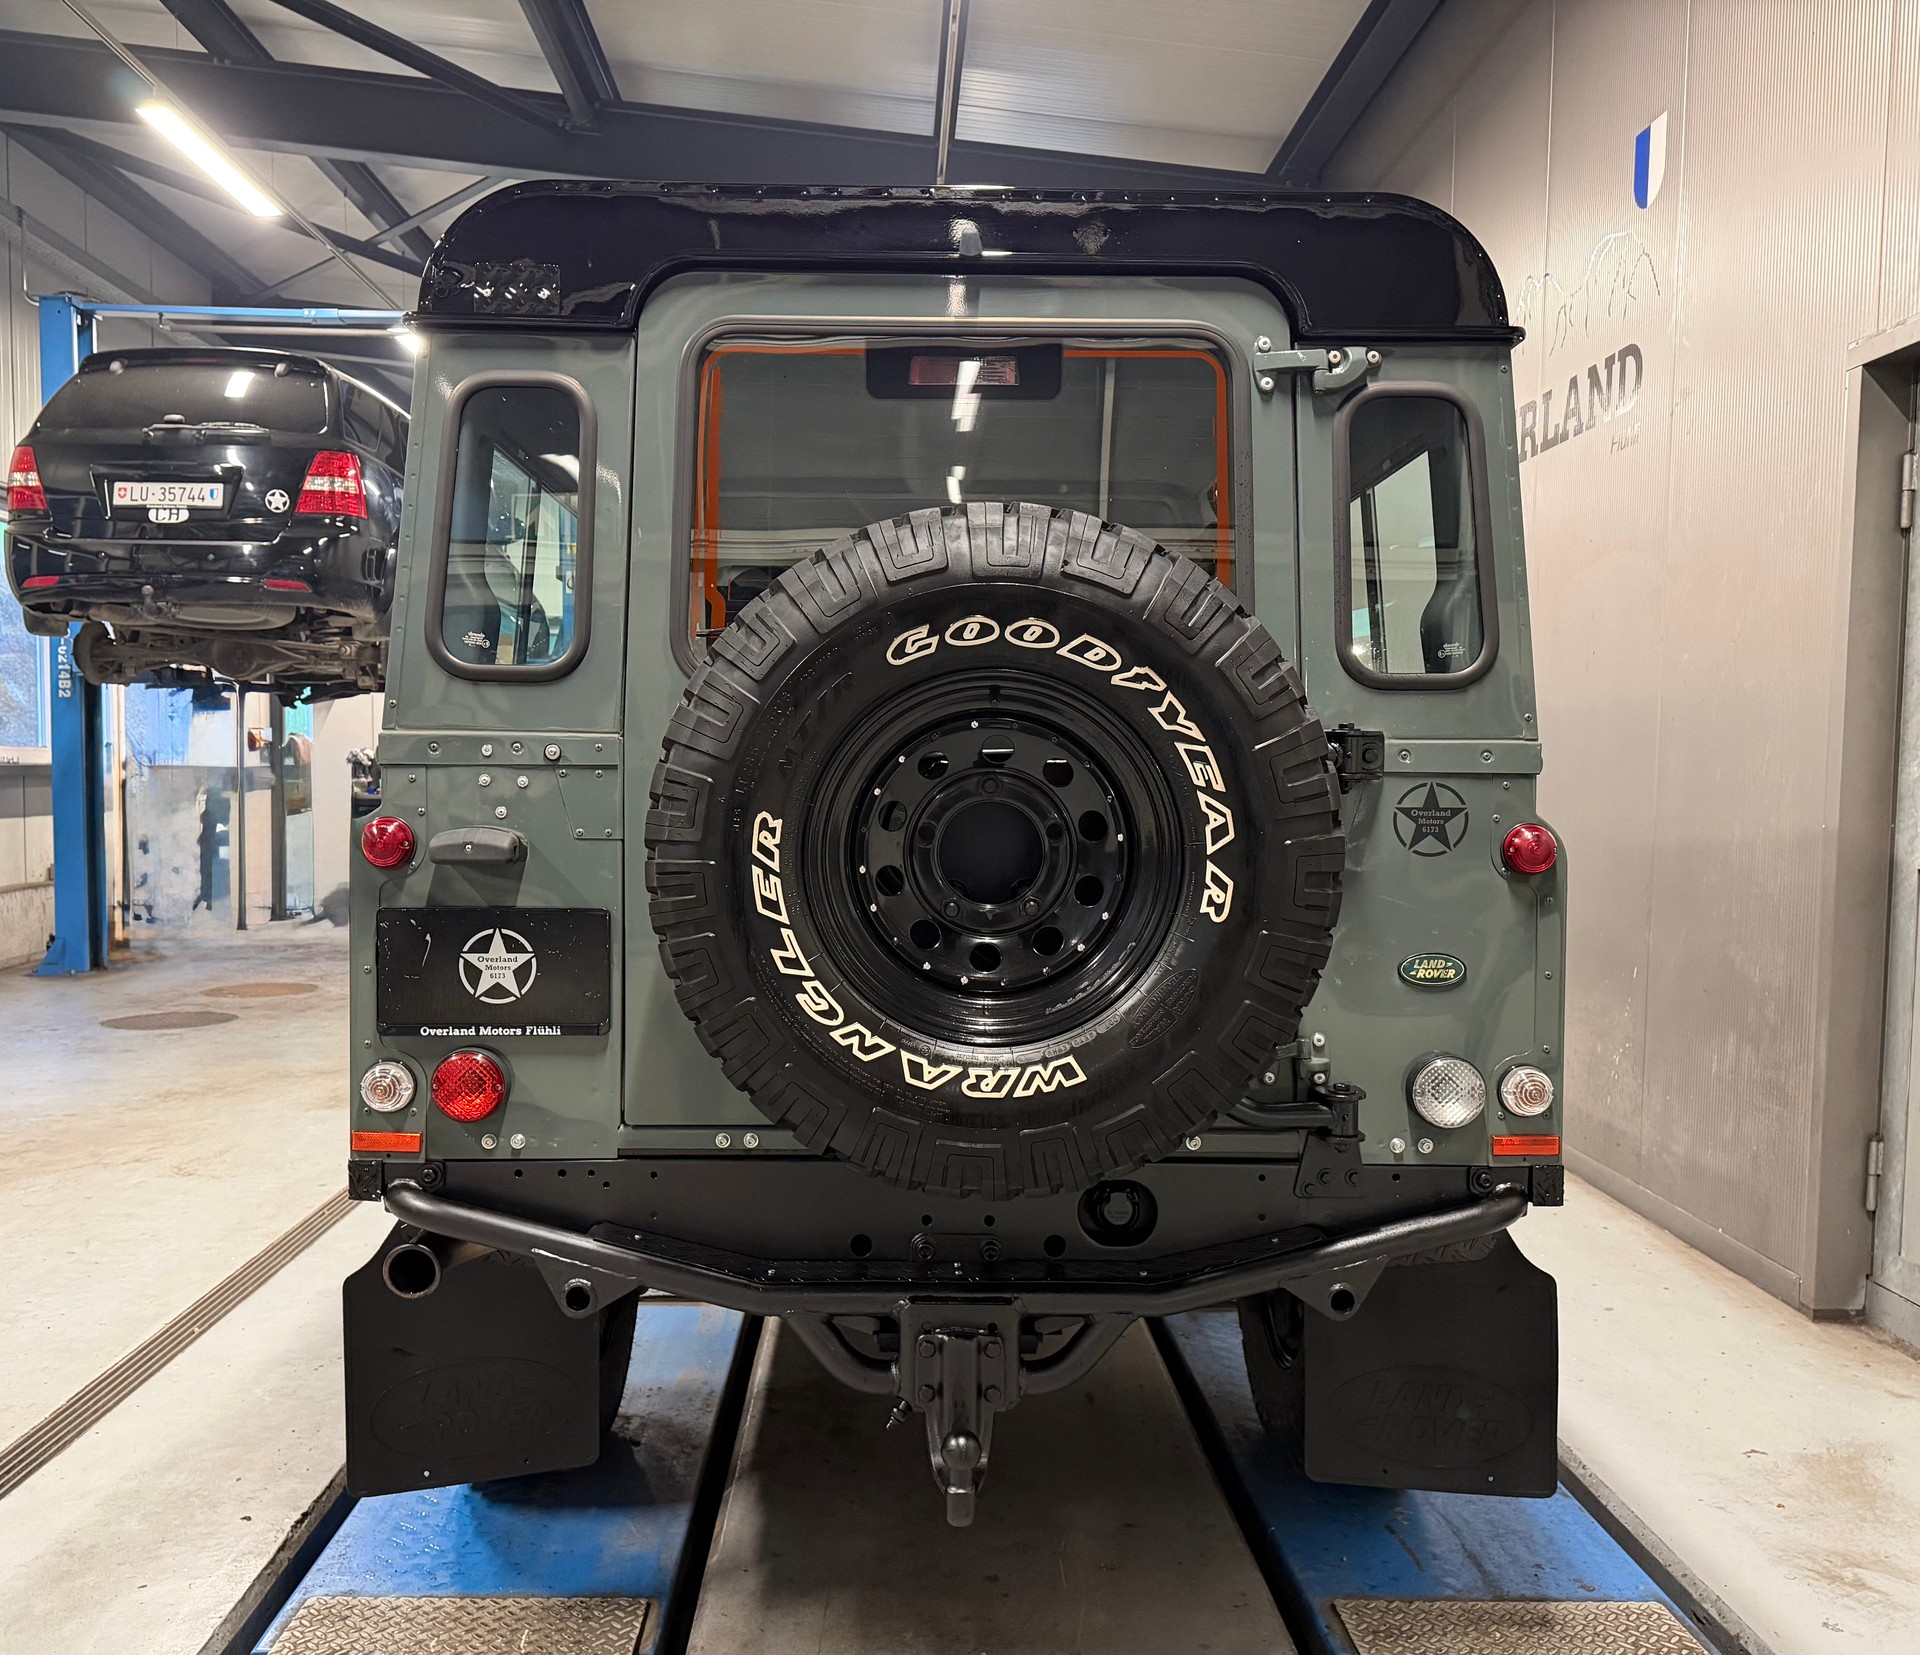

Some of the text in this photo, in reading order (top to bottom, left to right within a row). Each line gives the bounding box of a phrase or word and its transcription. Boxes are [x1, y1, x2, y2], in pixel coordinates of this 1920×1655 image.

[1516, 343, 1643, 464] RLAND
[155, 508, 180, 521] CH
[885, 616, 1235, 924] GOODYEAR
[1411, 809, 1451, 817] Overland
[746, 809, 1088, 1100] WRANGLER
[1413, 959, 1446, 969] LAND
[1416, 969, 1456, 979] ROVER
[420, 1025, 562, 1036] Overland Motors Flühli
